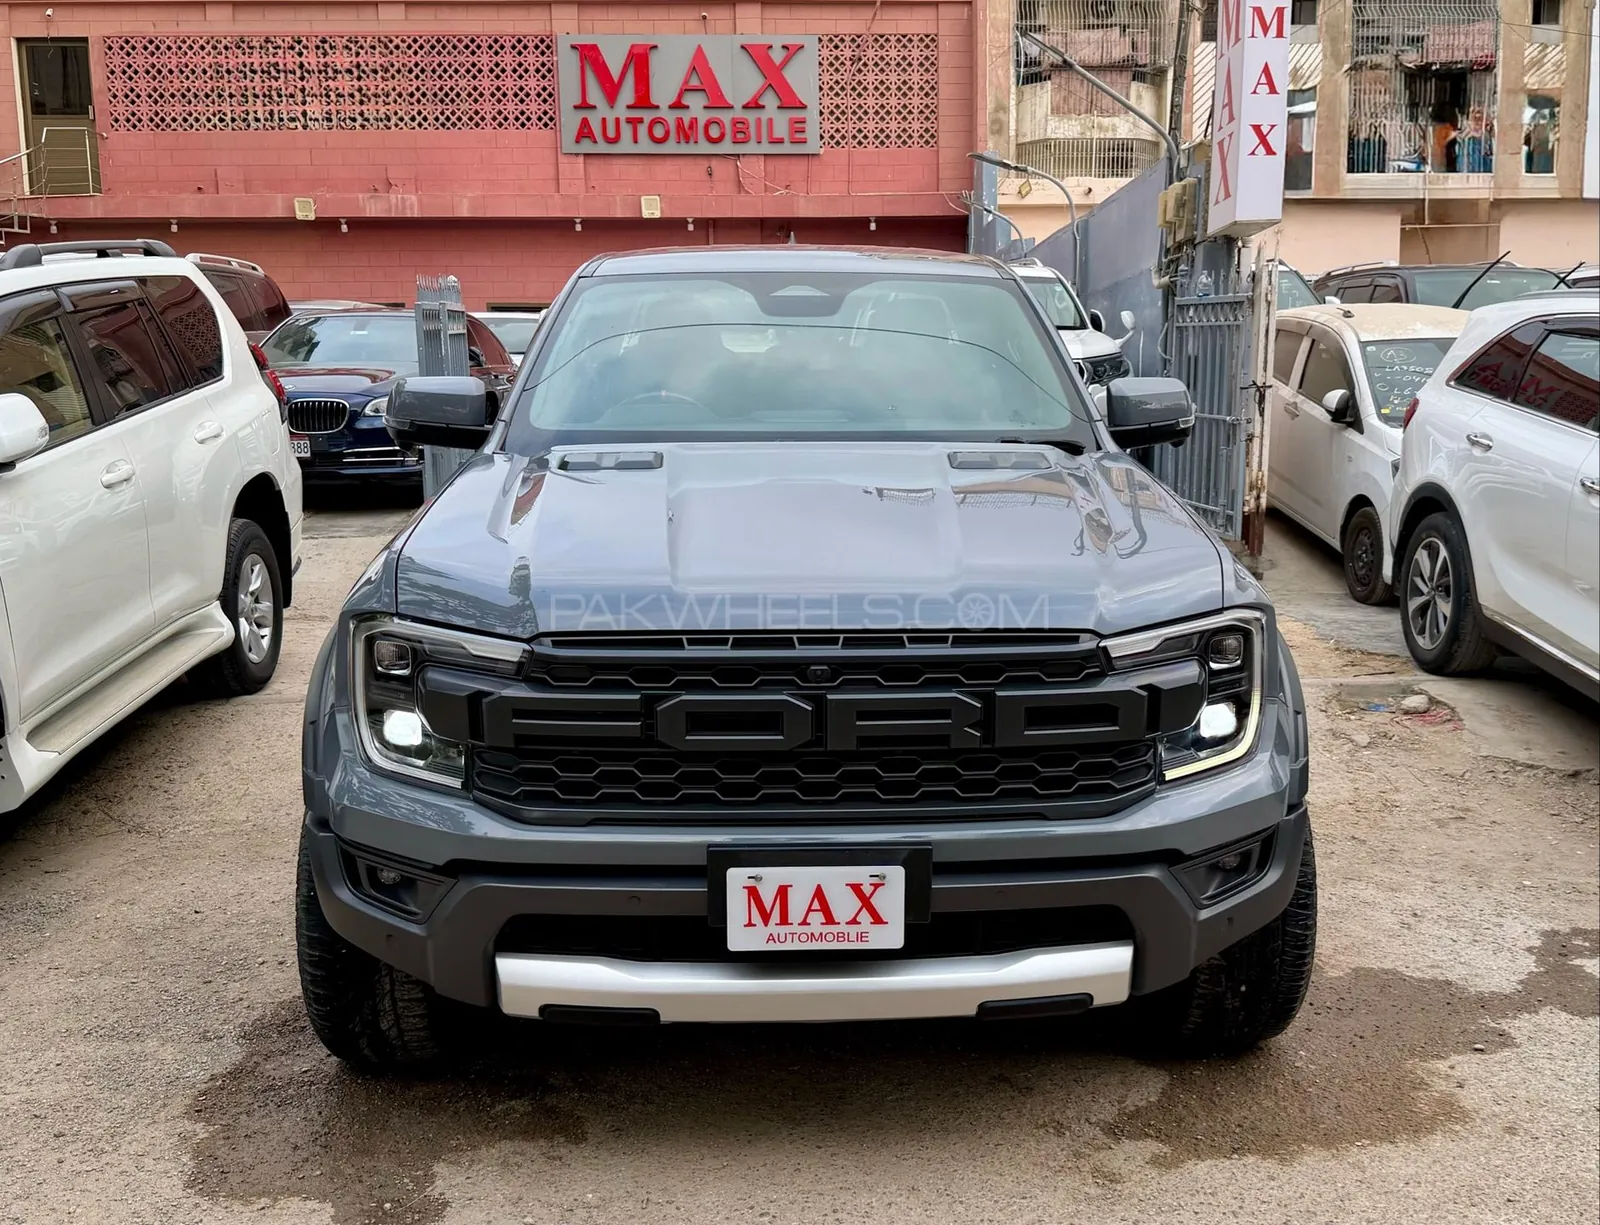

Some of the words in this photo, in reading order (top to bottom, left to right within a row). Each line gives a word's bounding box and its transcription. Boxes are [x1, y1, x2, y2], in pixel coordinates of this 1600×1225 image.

[570, 43, 808, 109] MAX
[1247, 6, 1288, 156] MAX
[574, 116, 808, 144] AUTOMOBILE
[484, 688, 1148, 752] FORD
[742, 882, 889, 927] MAX
[765, 931, 870, 944] AUTOMOBLIE
